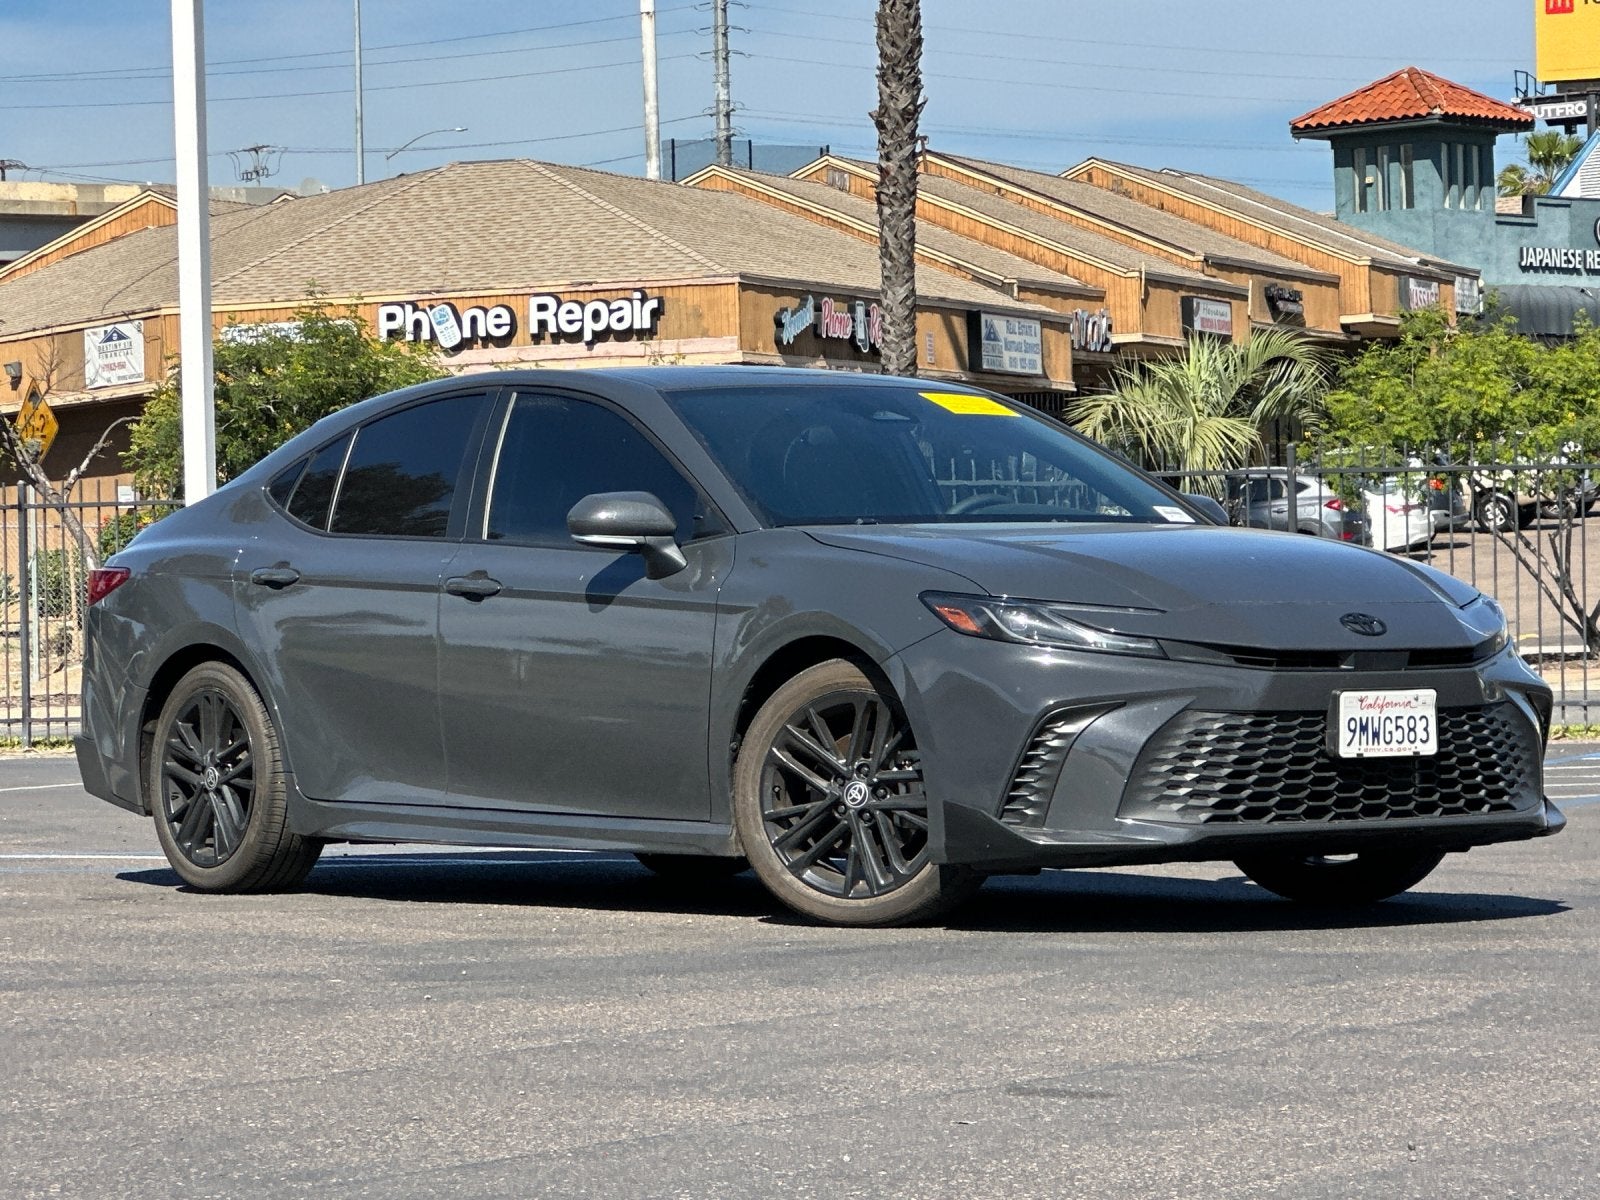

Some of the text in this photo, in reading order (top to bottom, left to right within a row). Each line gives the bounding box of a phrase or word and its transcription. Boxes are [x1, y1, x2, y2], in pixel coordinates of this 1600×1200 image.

[1520, 246, 1582, 269] JAPANESE
[529, 291, 659, 342] Repair
[821, 297, 852, 340] Phone
[1359, 695, 1417, 714] California
[1346, 715, 1429, 746] 9MWG583
